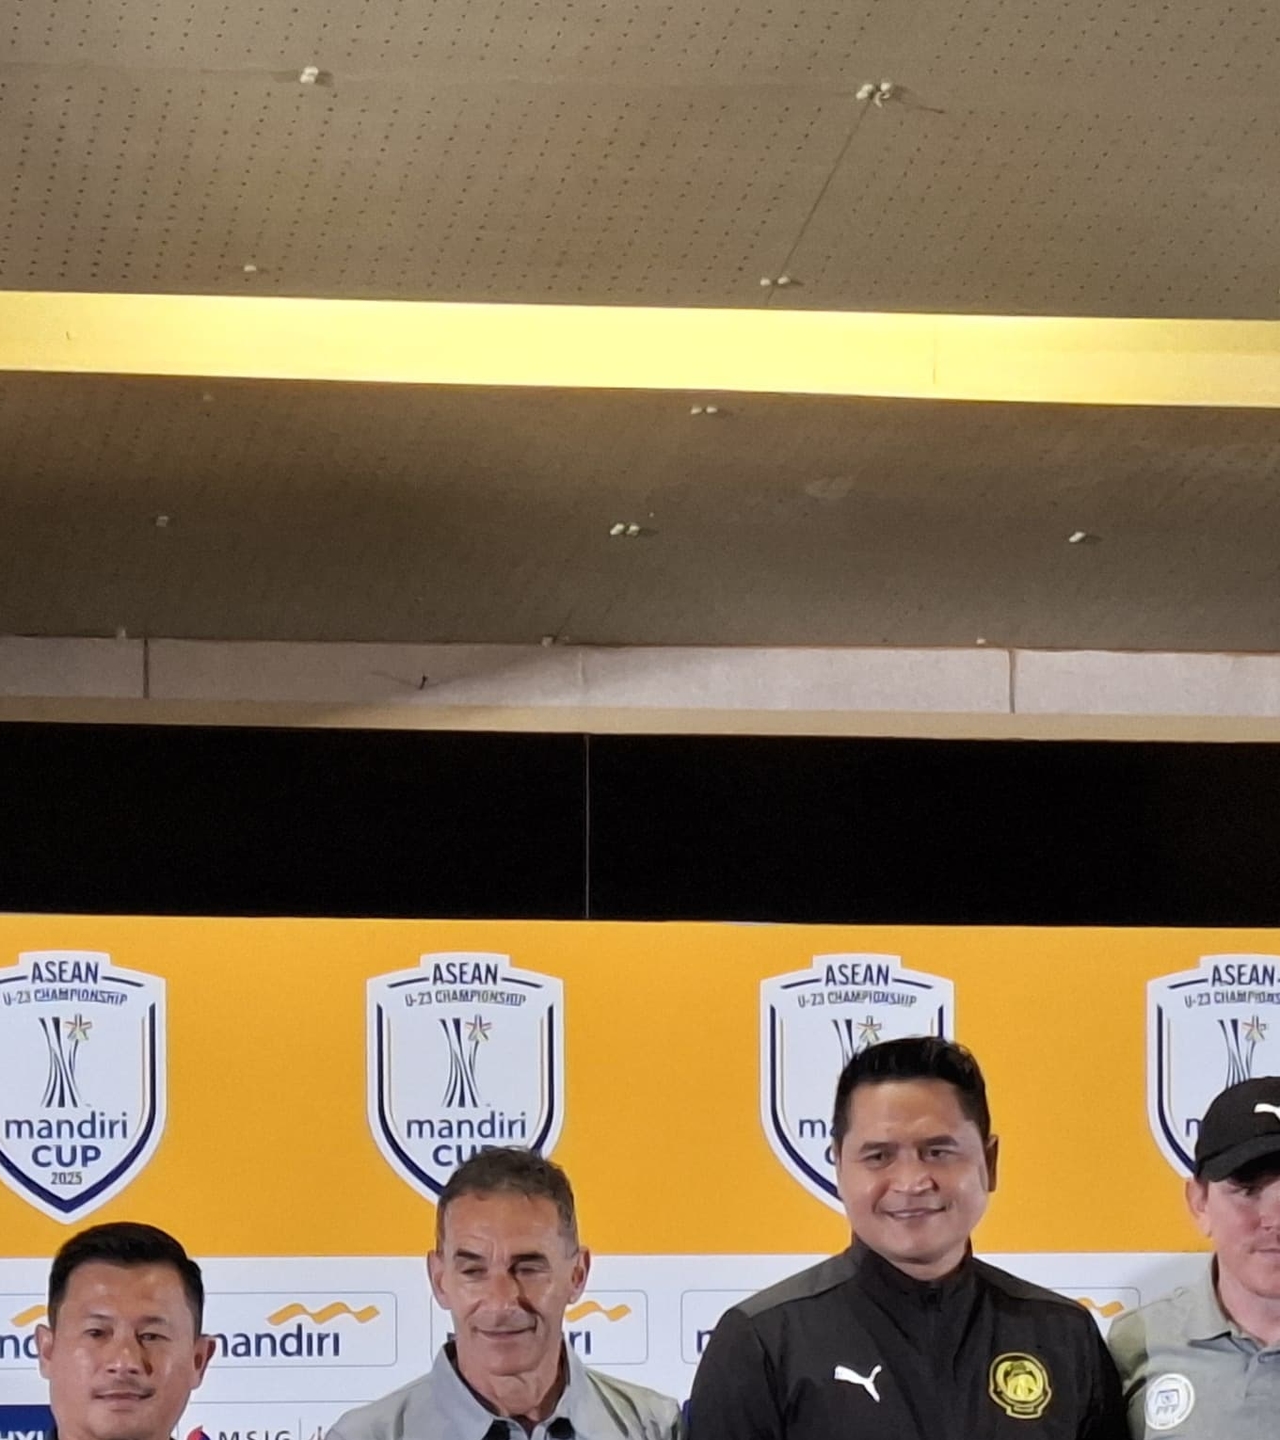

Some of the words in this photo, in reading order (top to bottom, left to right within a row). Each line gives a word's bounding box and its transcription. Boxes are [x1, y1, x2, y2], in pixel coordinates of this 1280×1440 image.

[32, 961, 98, 984] ASEAN
[433, 963, 497, 985] ASEAN
[826, 964, 889, 986] ASEAN
[1212, 964, 1274, 986] ASEAN
[5, 1112, 127, 1139] mandiri
[407, 1111, 525, 1138] mandiri
[32, 1145, 101, 1167] CUP
[432, 1144, 495, 1167] CU
